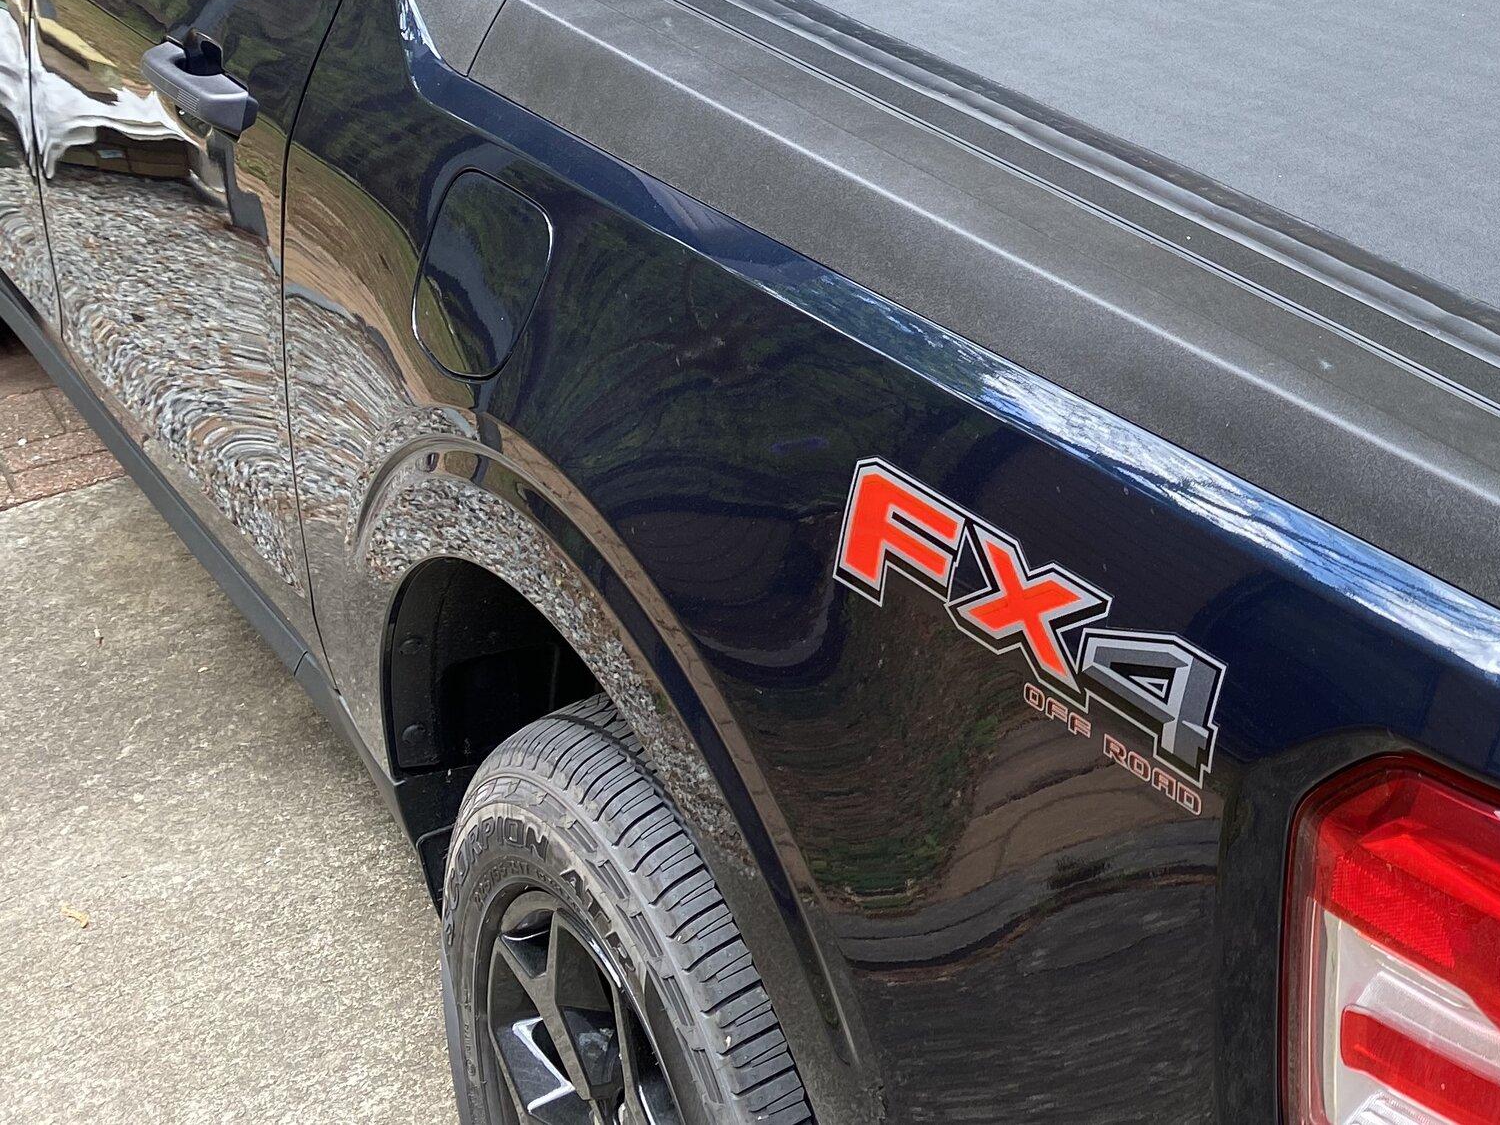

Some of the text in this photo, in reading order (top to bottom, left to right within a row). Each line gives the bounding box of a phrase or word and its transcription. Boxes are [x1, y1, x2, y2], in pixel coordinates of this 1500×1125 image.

[833, 455, 1228, 789] FX4
[1023, 682, 1202, 816] OFF ROAD
